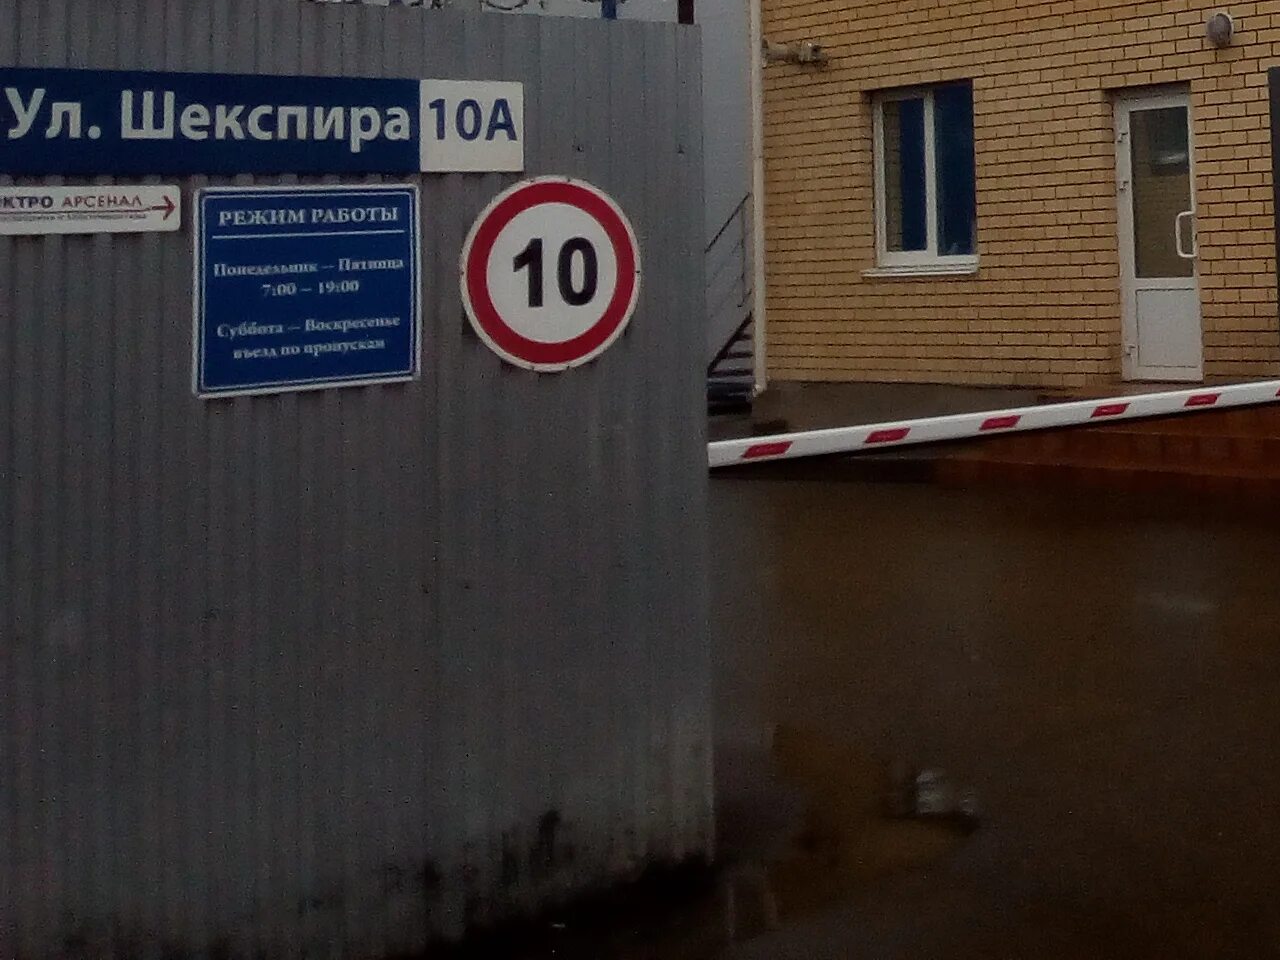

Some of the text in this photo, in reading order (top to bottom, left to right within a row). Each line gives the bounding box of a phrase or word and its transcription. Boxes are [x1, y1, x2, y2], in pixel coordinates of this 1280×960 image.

[4, 87, 518, 153] Ул. Шекспира 10А
[62, 194, 142, 209] АРСЕНАЛ
[218, 207, 399, 226] РЕЖИМ РАБОТЫ
[213, 263, 319, 278] Понедельник
[338, 257, 405, 273] Пятница
[513, 237, 599, 309] 10
[261, 283, 298, 297] 7:00
[318, 280, 360, 294] 19:00
[216, 321, 284, 340] Суббота
[304, 316, 401, 333] Воскресенье
[281, 345, 301, 356] по
